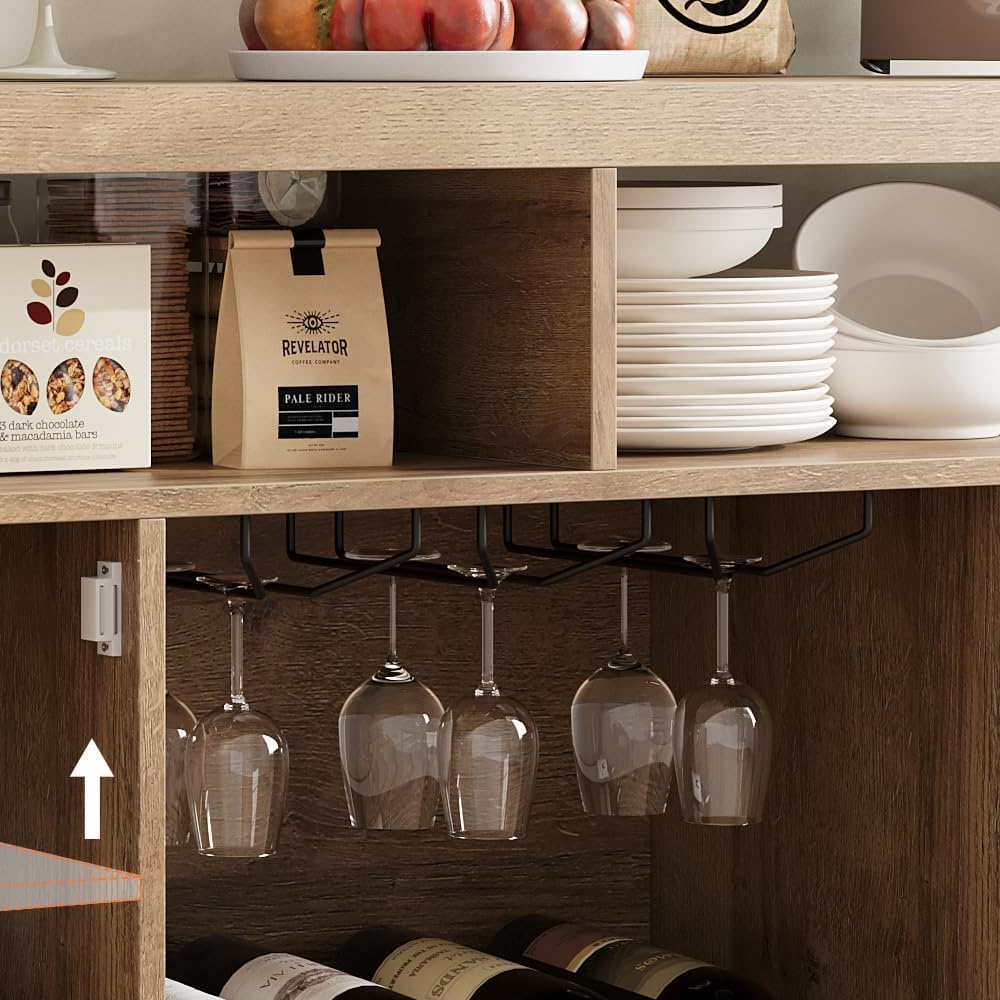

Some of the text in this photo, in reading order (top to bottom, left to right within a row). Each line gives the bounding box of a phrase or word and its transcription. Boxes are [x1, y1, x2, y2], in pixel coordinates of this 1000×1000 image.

[63, 335, 133, 352] cereals
[282, 339, 348, 356] REVELATOR
[284, 393, 351, 404] PALE RIDER
[0, 419, 85, 431] 3 dark chocolate
[0, 430, 98, 442] & macadamia bars
